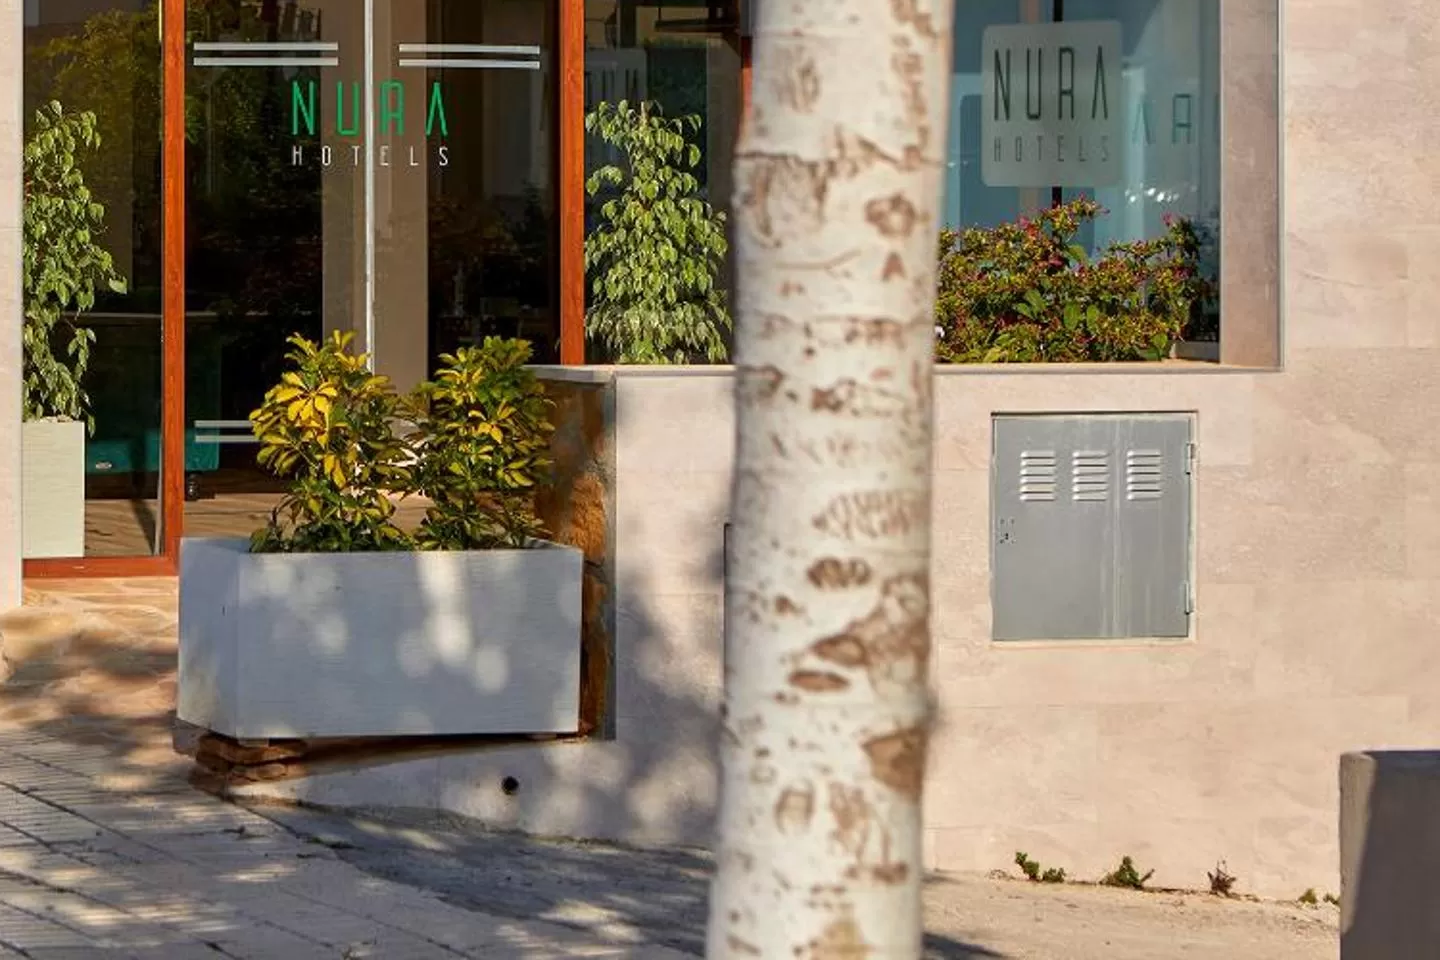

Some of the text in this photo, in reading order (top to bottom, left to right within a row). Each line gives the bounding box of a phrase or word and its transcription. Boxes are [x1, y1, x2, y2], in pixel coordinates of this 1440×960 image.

[993, 45, 1110, 122] NURA
[291, 80, 450, 136] NURA
[292, 145, 450, 167] HOTELS
[993, 135, 1110, 163] HOTELS
